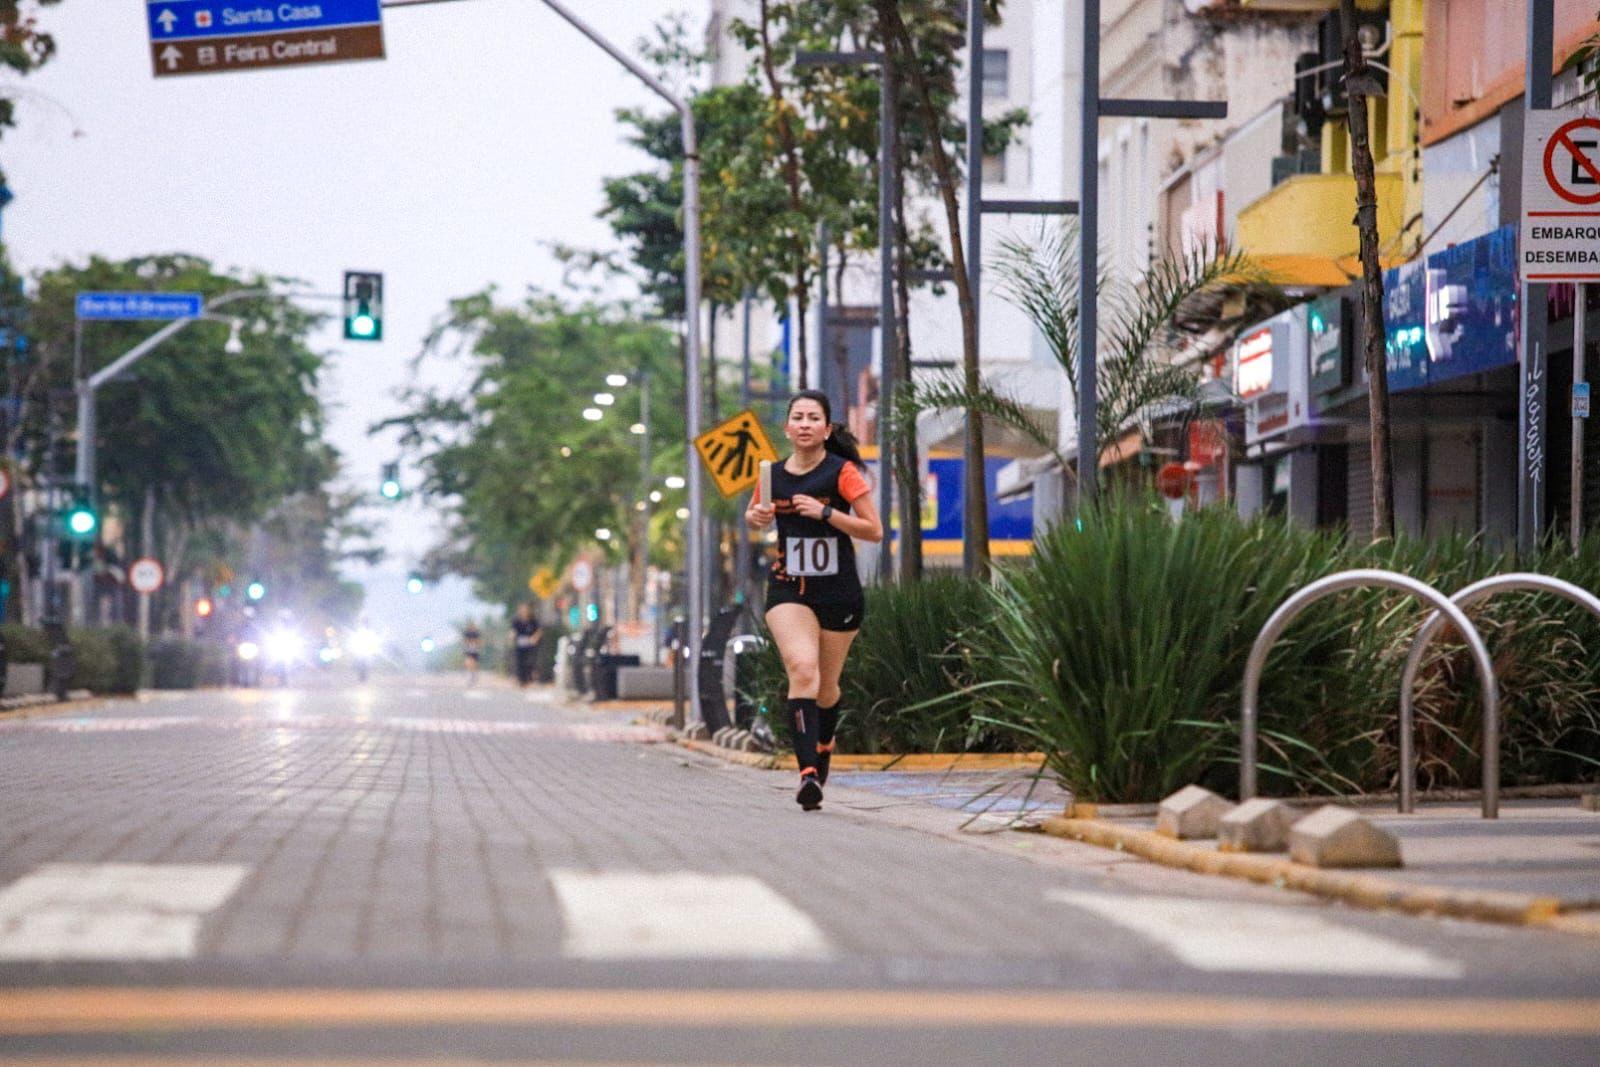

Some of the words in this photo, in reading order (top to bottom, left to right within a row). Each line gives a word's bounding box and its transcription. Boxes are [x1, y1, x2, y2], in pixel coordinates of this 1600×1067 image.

[222, 8, 274, 26] Santa
[277, 3, 322, 22] Casa
[224, 42, 270, 63] Feira
[272, 36, 338, 59] Central
[1532, 227, 1600, 240] EMBARQ
[1525, 251, 1600, 263] DESEMBA
[793, 538, 830, 572] 10
